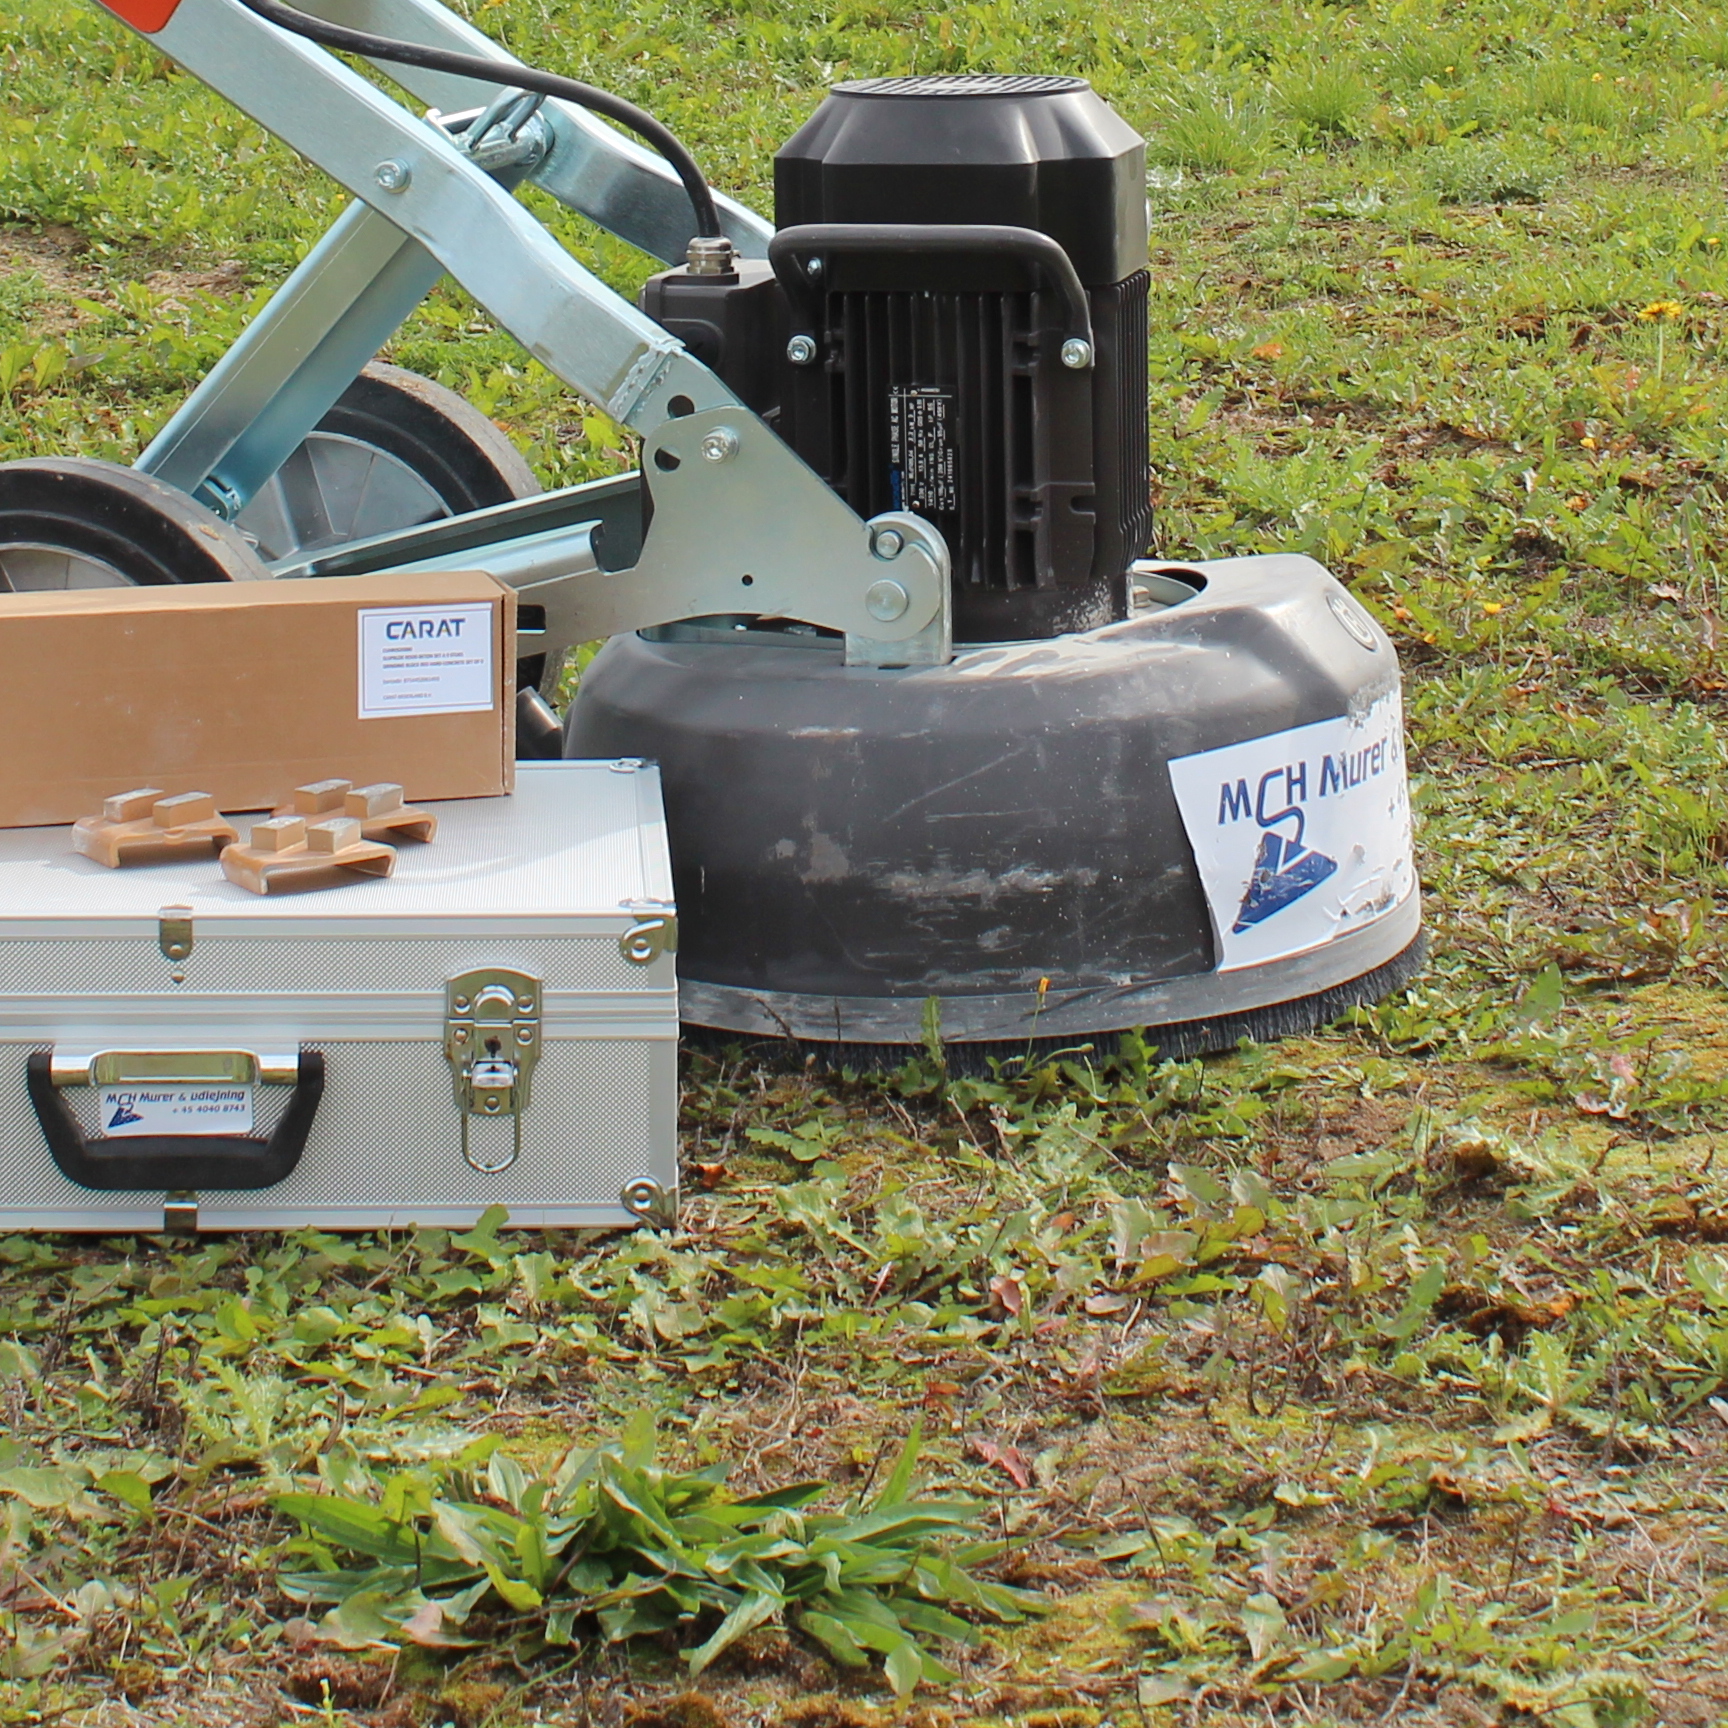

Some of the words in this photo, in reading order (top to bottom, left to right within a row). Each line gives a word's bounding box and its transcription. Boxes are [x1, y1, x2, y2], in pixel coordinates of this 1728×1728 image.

[386, 618, 466, 640] CARAT
[1218, 761, 1307, 828] MCH
[1319, 736, 1387, 797] Murer
[106, 1092, 137, 1106] MCH
[138, 1092, 174, 1103] Murer
[178, 1092, 187, 1102] &
[190, 1090, 246, 1102] udlejning
[197, 1105, 220, 1113] 4040
[223, 1104, 246, 1112] 8743
